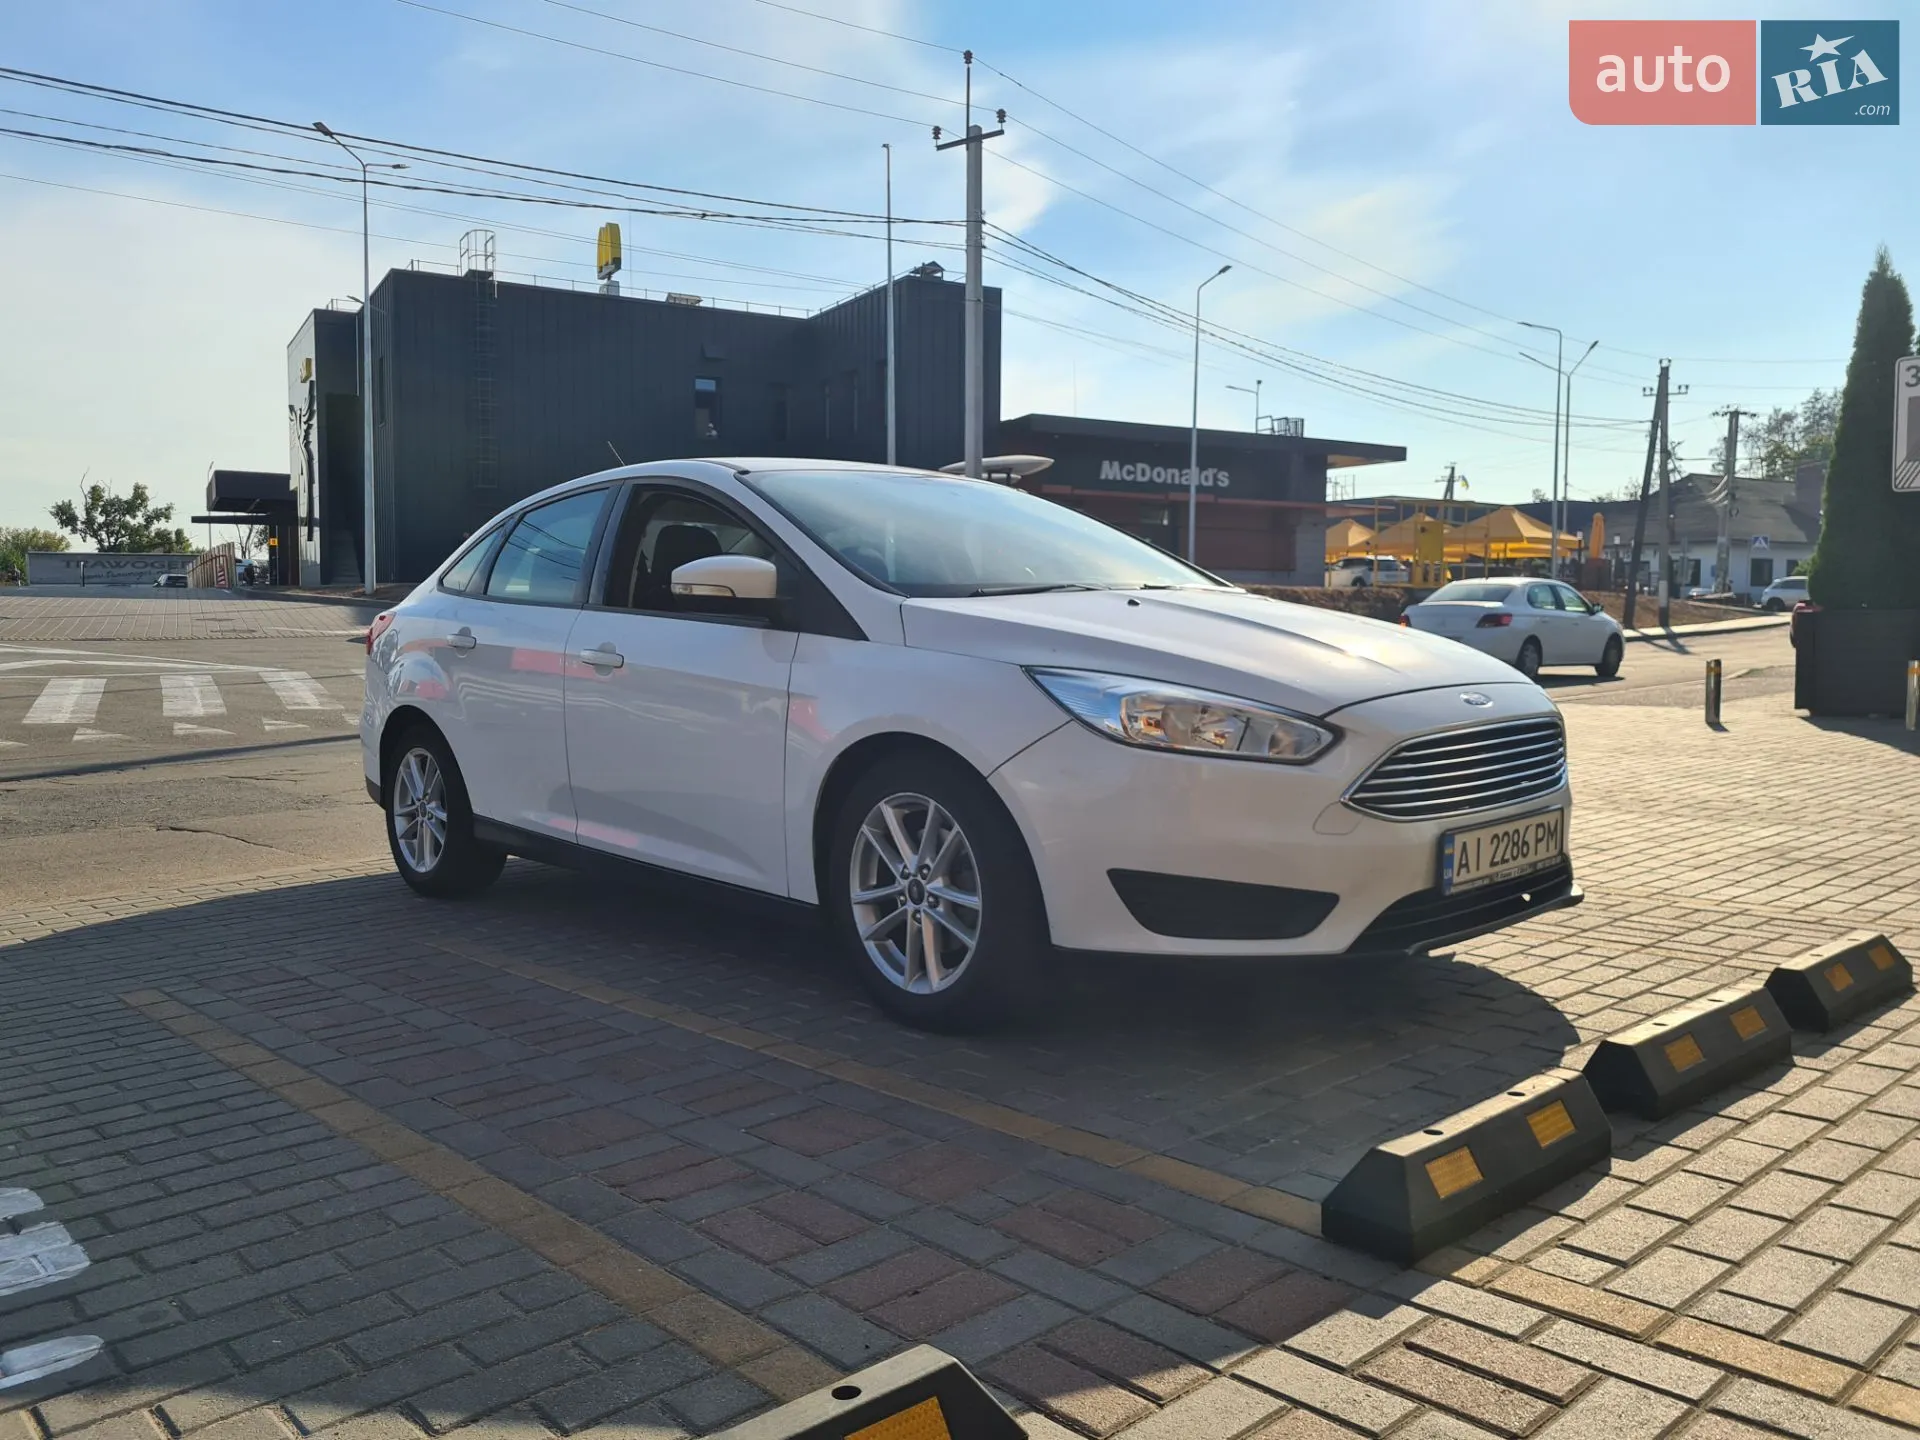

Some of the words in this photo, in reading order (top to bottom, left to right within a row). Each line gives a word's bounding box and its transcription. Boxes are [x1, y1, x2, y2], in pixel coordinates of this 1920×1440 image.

[1099, 460, 1230, 488] McDonald's
[1456, 837, 1481, 877] AI
[1489, 823, 1532, 867] 2286
[1534, 818, 1559, 856] PM
